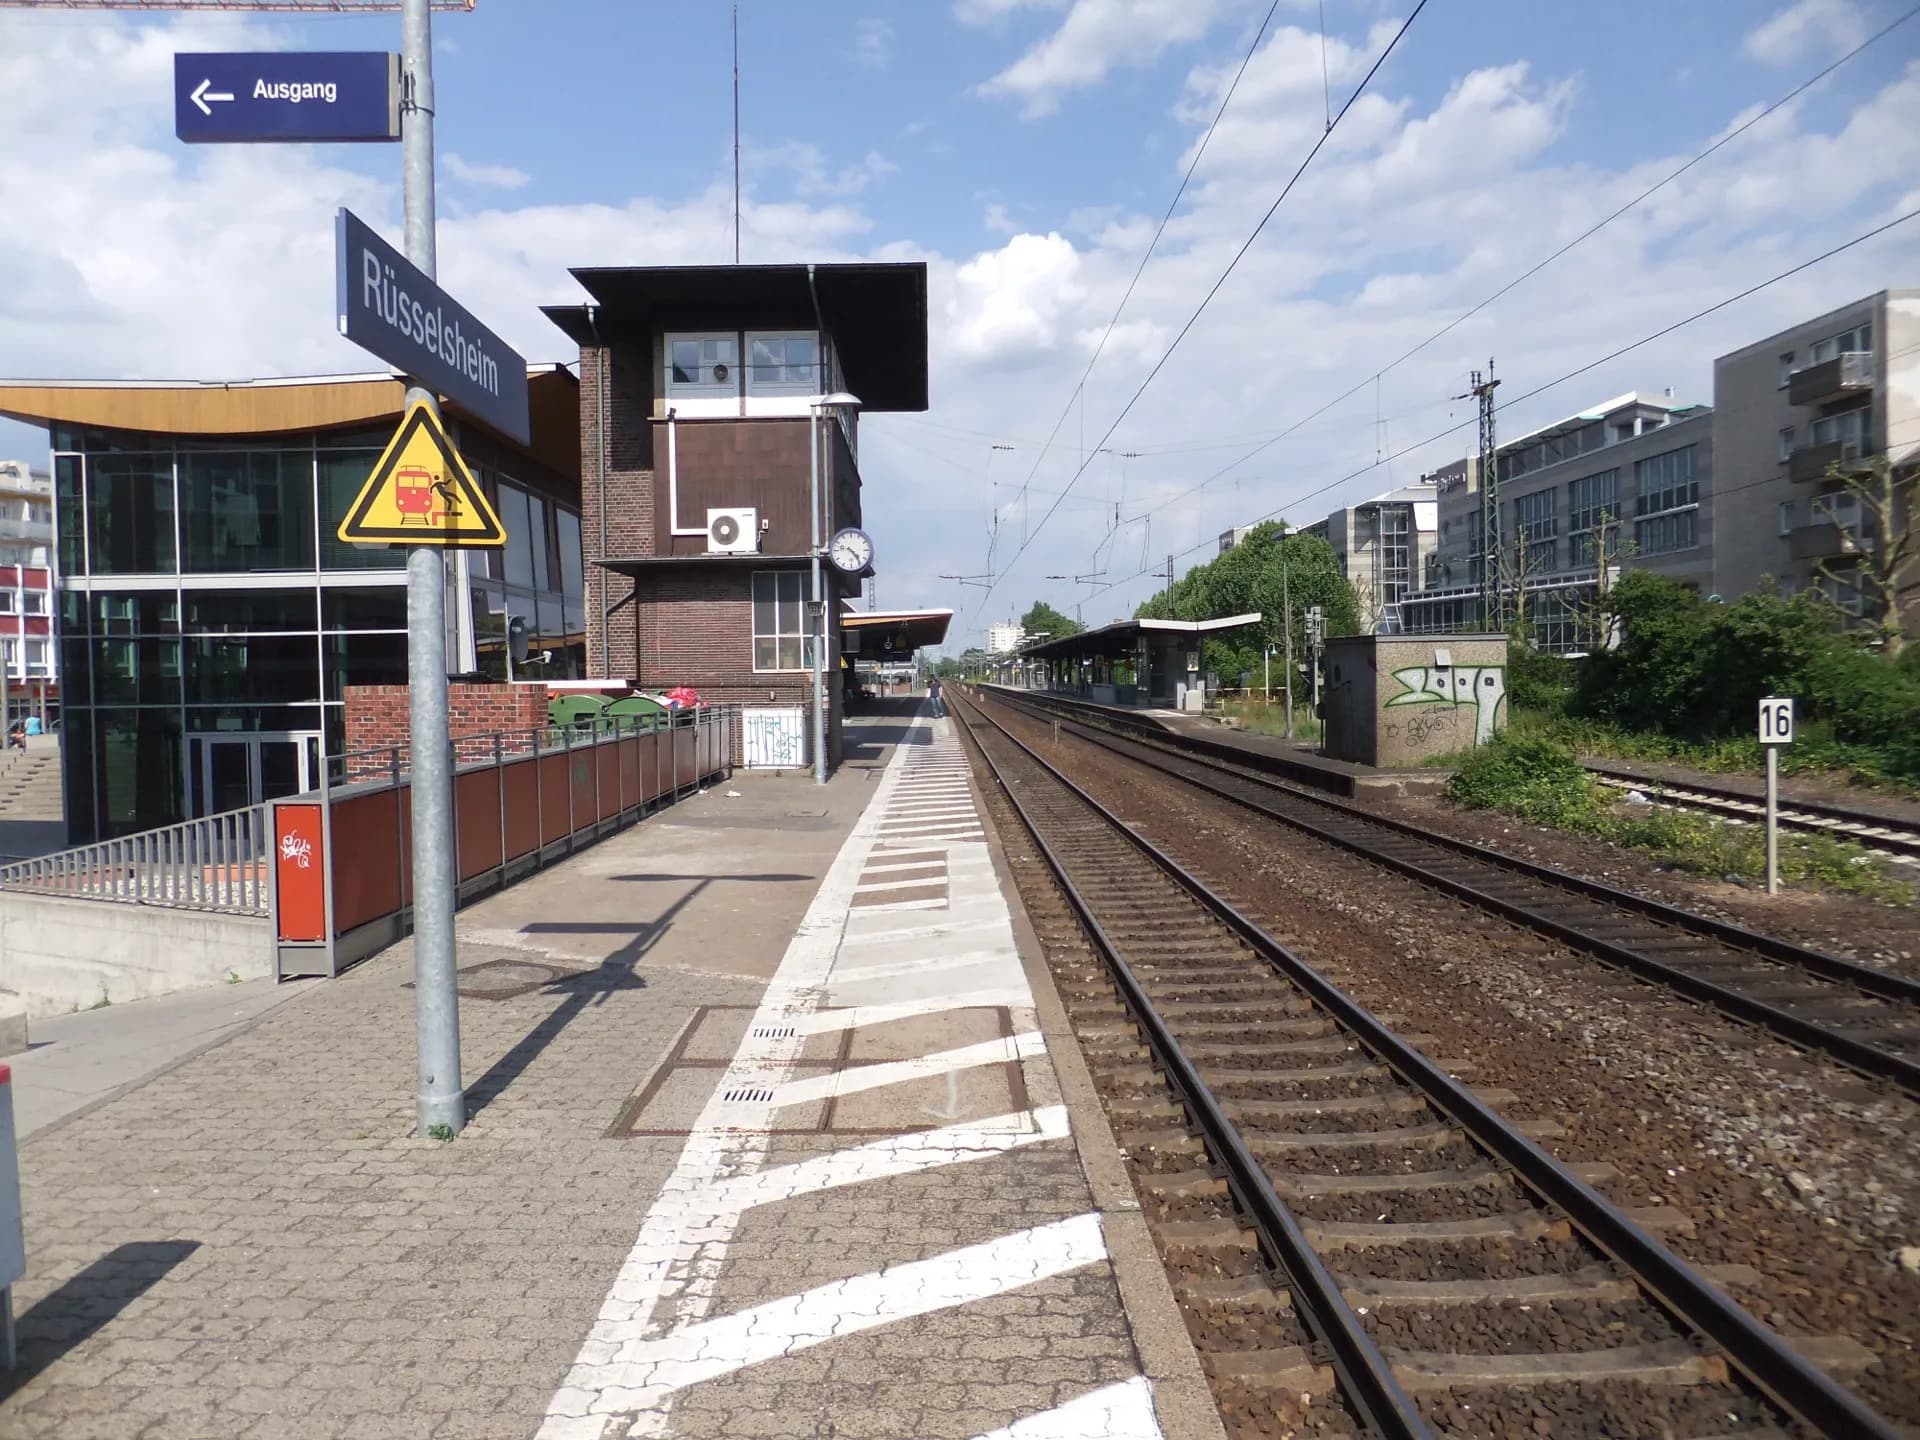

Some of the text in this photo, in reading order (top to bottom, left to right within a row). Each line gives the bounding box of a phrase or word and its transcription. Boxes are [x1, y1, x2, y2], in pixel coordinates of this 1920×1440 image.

[253, 78, 337, 103] Ausgang
[363, 248, 499, 396] Rüsselsheim
[1761, 705, 1790, 736] 16
